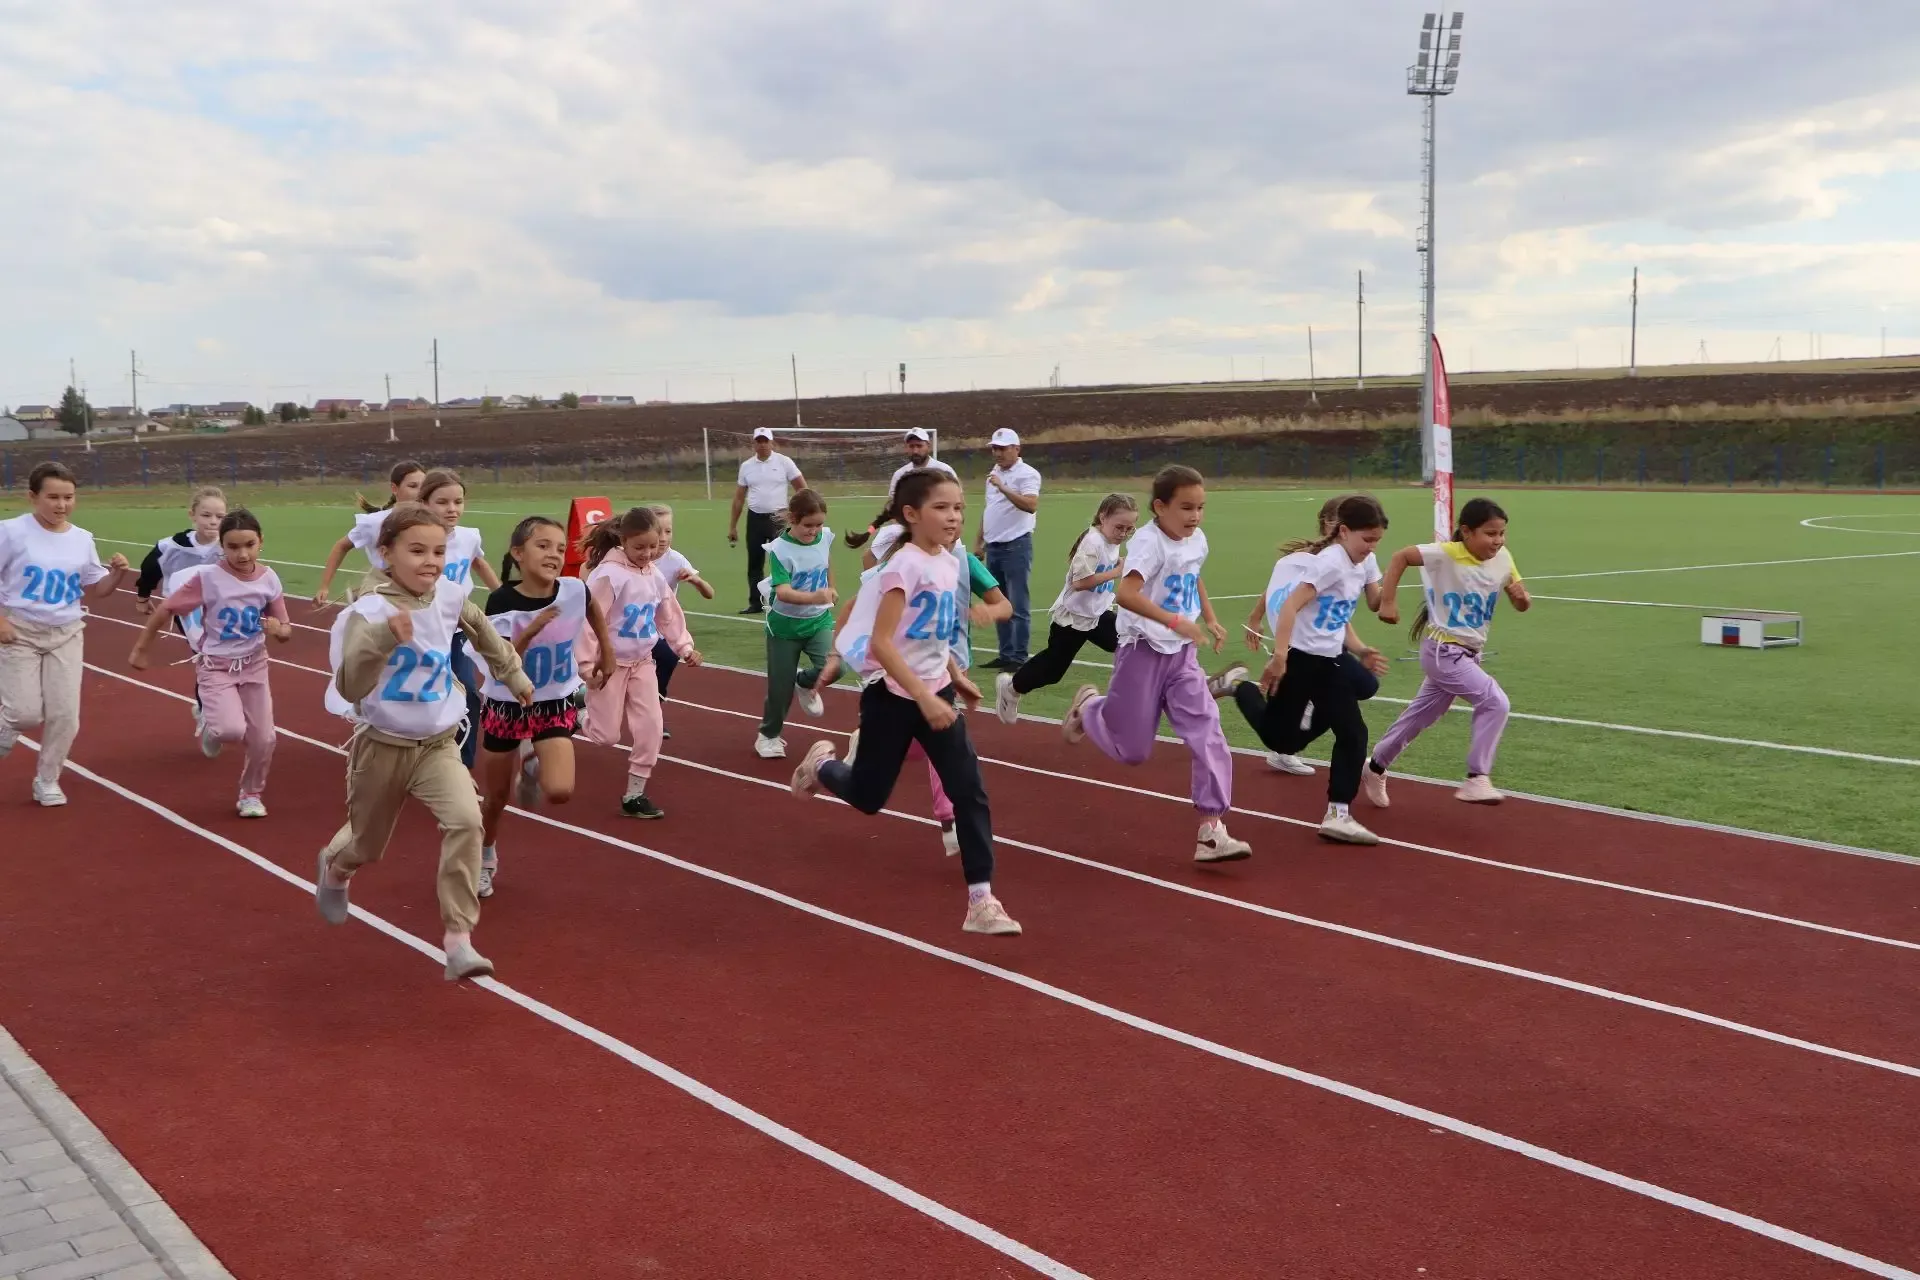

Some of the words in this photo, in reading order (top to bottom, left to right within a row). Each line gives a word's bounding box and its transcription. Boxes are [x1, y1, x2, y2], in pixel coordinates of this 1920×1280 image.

[618, 603, 657, 638] 22
[1314, 596, 1357, 631] 19
[382, 646, 452, 702] 22
[500, 640, 573, 689] 05
